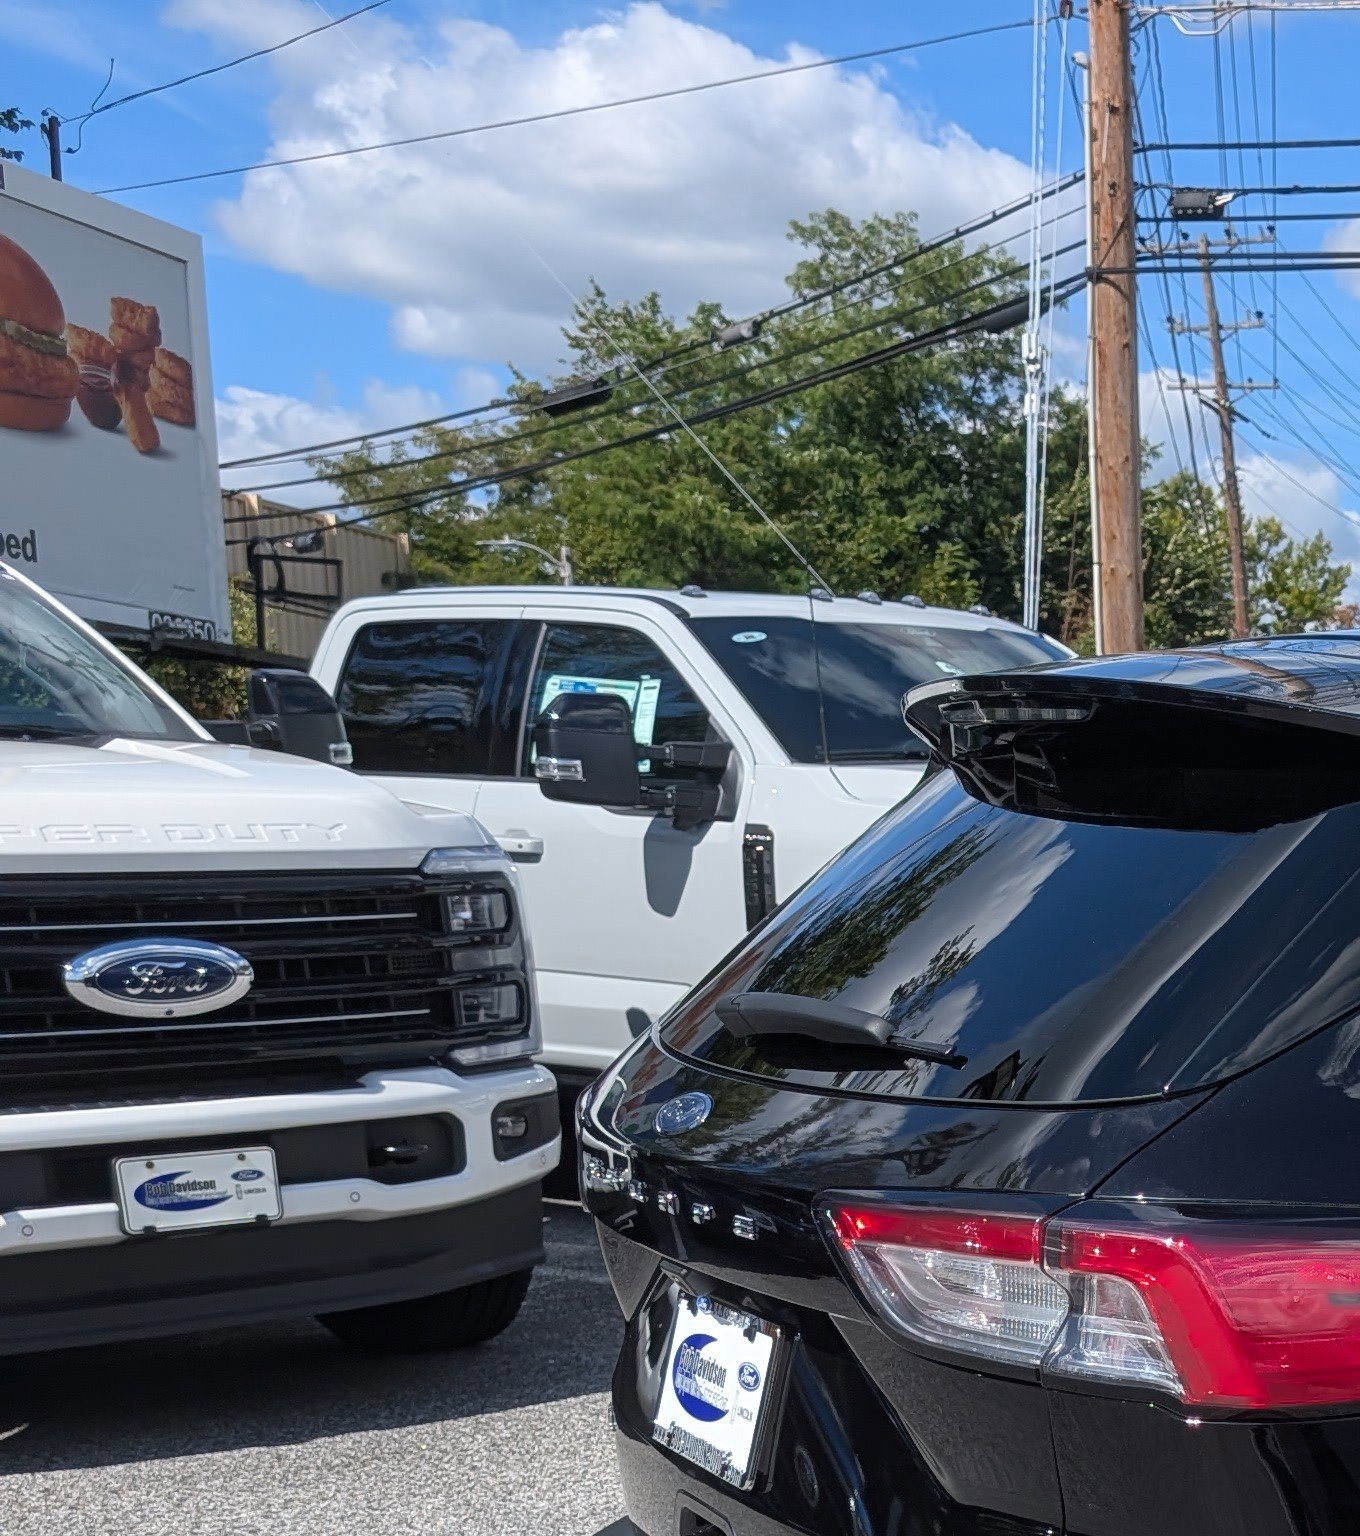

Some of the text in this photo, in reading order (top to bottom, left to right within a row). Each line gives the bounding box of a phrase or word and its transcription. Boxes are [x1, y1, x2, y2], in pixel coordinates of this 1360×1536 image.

[0, 529, 38, 562] ed
[161, 823, 347, 843] DUTY
[123, 961, 209, 995] Ford
[145, 1179, 217, 1198] Bob Davidson
[679, 1342, 728, 1388] Bob Davidson
